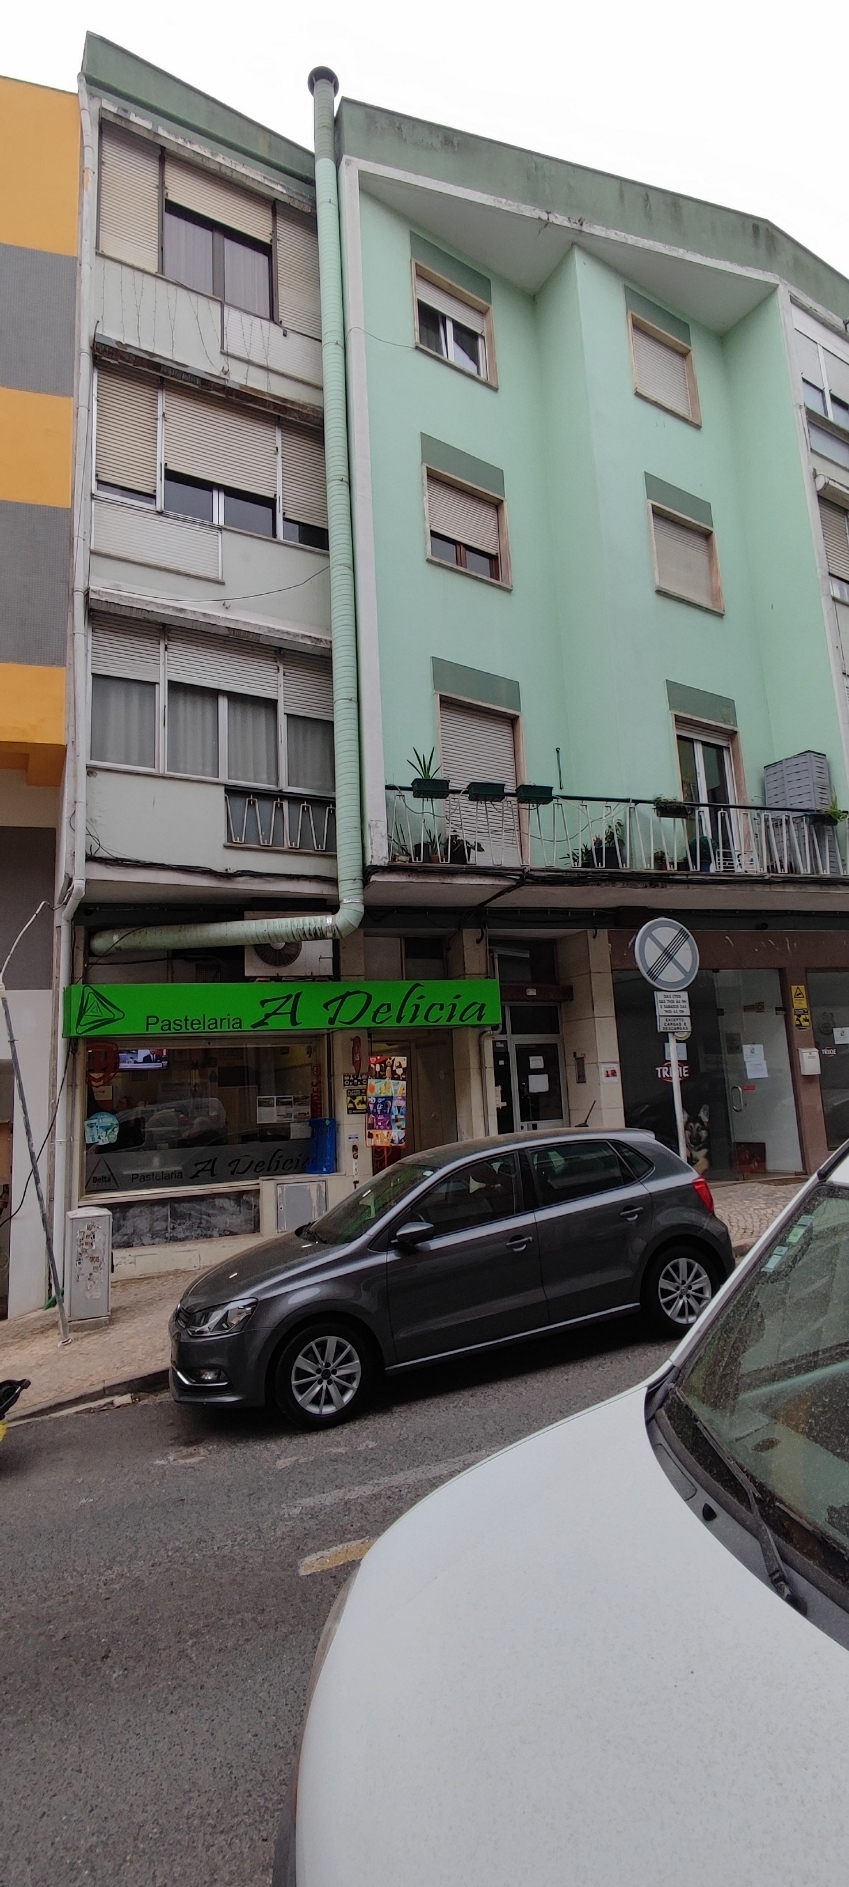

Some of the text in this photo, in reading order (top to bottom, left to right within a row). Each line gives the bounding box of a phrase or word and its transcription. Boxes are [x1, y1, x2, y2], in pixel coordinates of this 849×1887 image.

[145, 983, 487, 1032] Pastelaria A Delicia
[655, 1065, 690, 1079] TRIIE
[92, 1175, 112, 1184] Delta
[131, 1170, 183, 1183] Pastelaria
[189, 1157, 217, 1180] A
